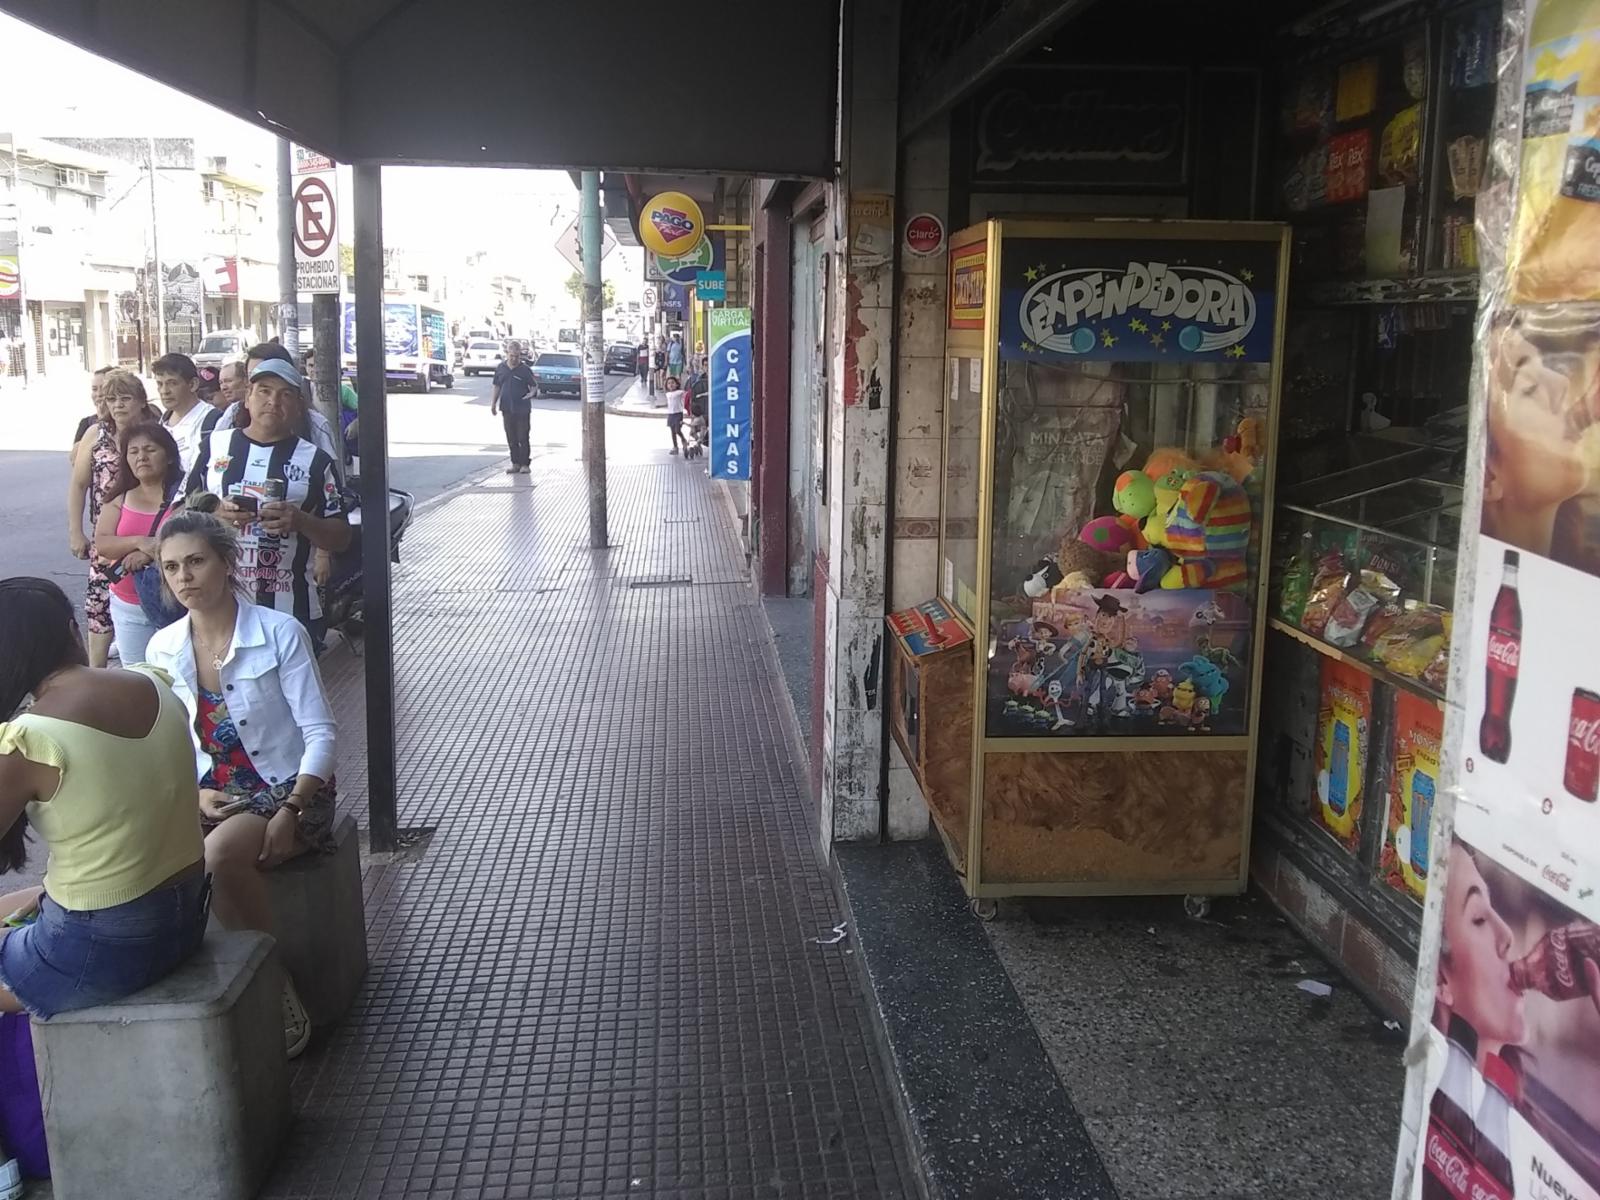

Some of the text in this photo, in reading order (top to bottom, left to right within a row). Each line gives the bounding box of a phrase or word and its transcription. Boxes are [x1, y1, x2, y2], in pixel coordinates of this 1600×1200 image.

[651, 210, 694, 231] PAGO
[908, 229, 935, 240] Claro
[296, 260, 335, 274] PROHIBIDO
[297, 275, 338, 290] STACIONAR
[698, 280, 725, 290] SUBE
[663, 300, 682, 308] NSES
[1030, 262, 1247, 345] EXPENDEDORA
[712, 310, 744, 319] CARGA
[712, 318, 750, 327] VIRTUAL
[725, 349, 740, 475] CABINAS
[1488, 636, 1519, 667] Coca-Cola
[1428, 1134, 1470, 1194] Coca-Cola
